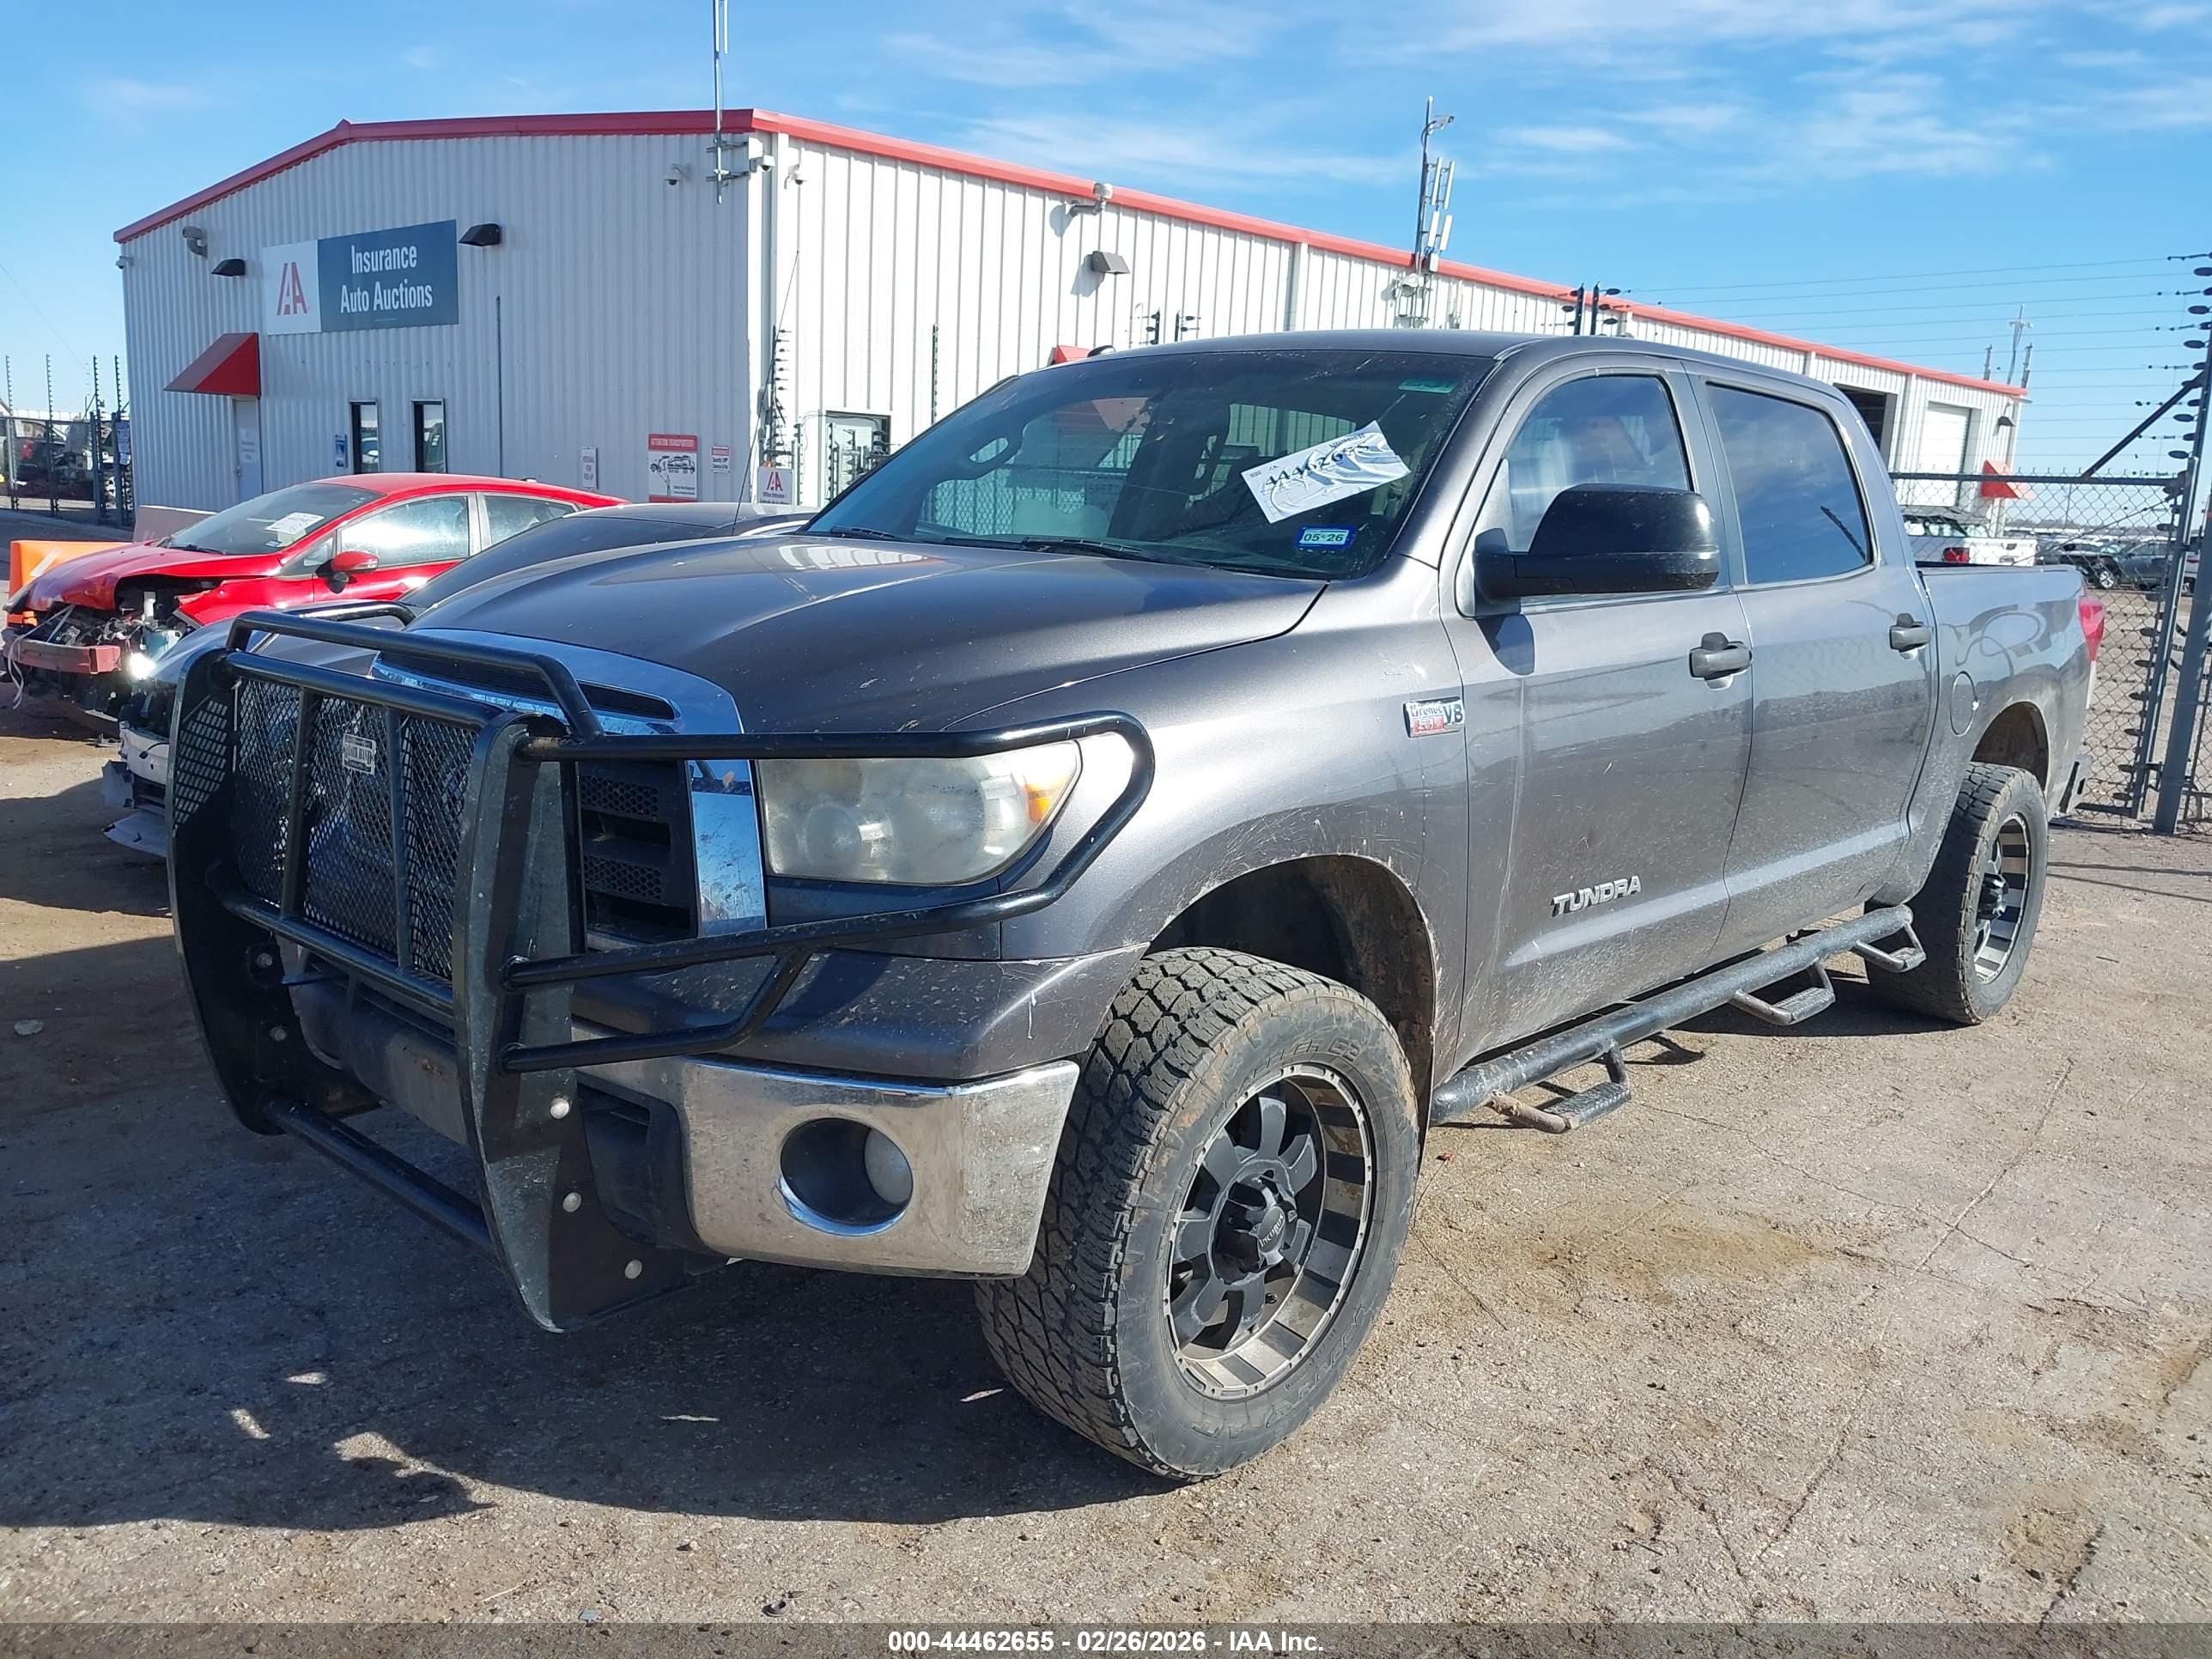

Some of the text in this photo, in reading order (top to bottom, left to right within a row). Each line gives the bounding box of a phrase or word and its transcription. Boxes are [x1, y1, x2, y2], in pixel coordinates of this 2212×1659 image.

[350, 245, 417, 274] Insurance
[340, 278, 433, 313] Auto Auctions
[1304, 533, 1346, 542] 05 26
[1552, 875, 1642, 915] TUNDRA
